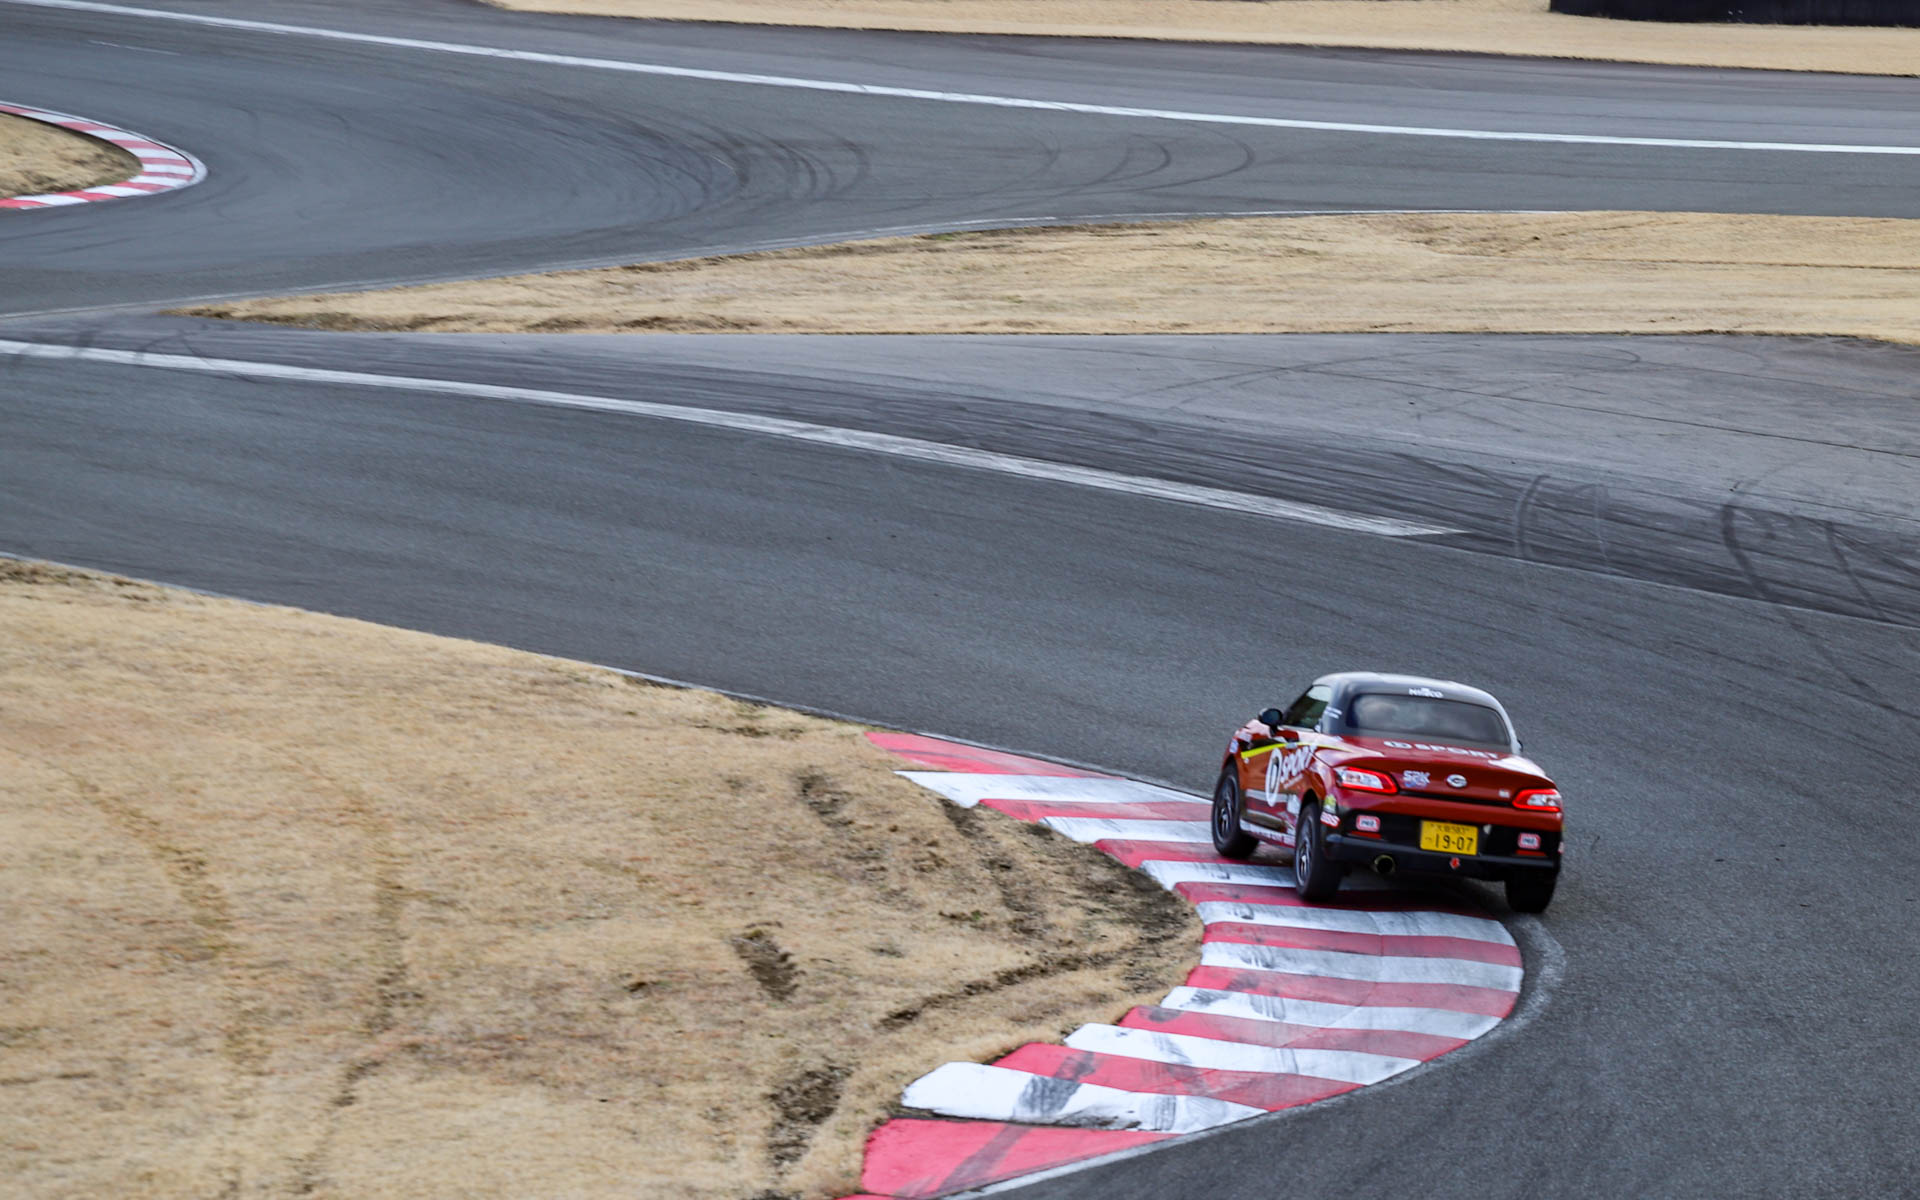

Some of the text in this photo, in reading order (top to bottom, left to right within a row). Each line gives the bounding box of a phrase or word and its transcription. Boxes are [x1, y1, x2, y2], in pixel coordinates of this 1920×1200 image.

[1414, 744, 1498, 759] SPORT
[1280, 745, 1317, 783] SPORT
[1435, 833, 1474, 851] 19-07
